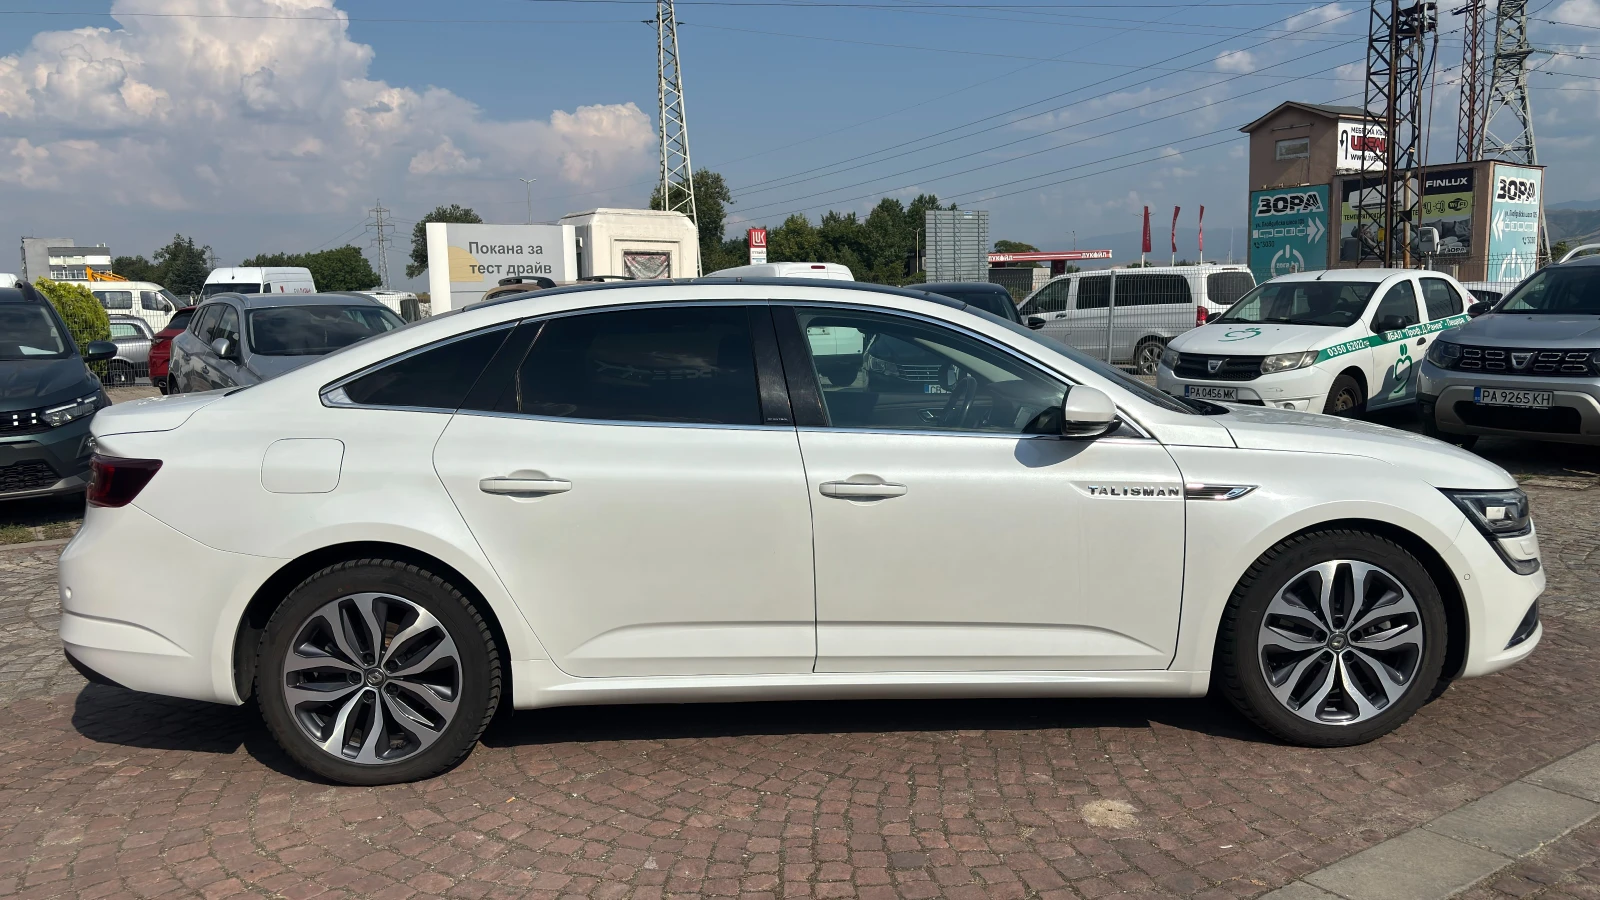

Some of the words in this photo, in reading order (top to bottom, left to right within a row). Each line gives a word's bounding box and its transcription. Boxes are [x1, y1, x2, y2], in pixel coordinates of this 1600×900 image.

[1425, 177, 1468, 188] FINLUX
[1495, 175, 1538, 205] ЗОРА
[1255, 191, 1324, 217] ЗОРА
[469, 241, 523, 255] Покана
[527, 243, 543, 255] за
[469, 263, 502, 275] тест
[507, 262, 552, 277] драйв
[1327, 343, 1346, 357] 0350
[1190, 387, 1200, 397] PA
[1202, 387, 1222, 398] 0456
[1223, 389, 1234, 399] MK
[1482, 390, 1498, 402] PA
[1501, 391, 1531, 404] 9265
[1532, 392, 1550, 405] KH
[1087, 485, 1179, 497] TALISMAN
